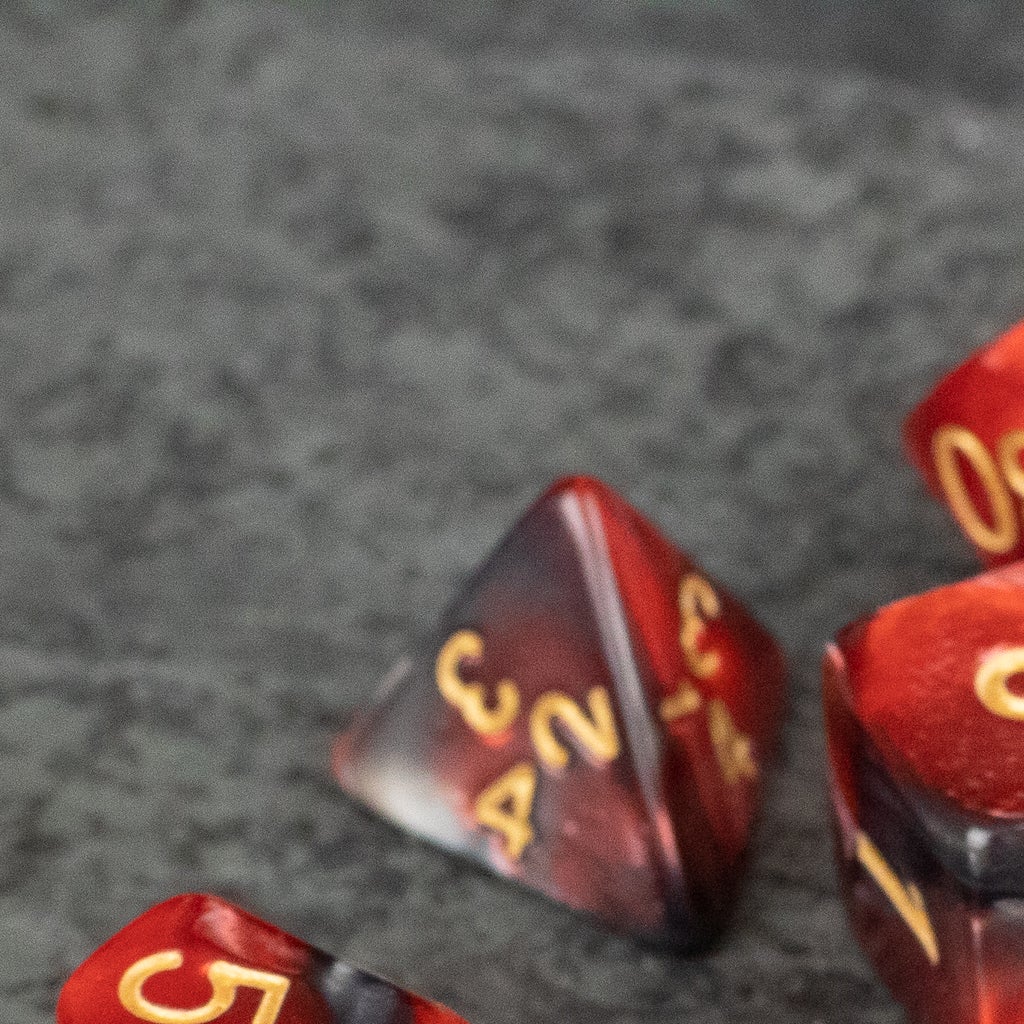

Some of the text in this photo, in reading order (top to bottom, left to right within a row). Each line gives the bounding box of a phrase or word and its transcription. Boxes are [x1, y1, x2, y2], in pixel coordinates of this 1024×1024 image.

[436, 629, 521, 736] 3
[529, 690, 620, 769] 2
[475, 763, 538, 862] 4
